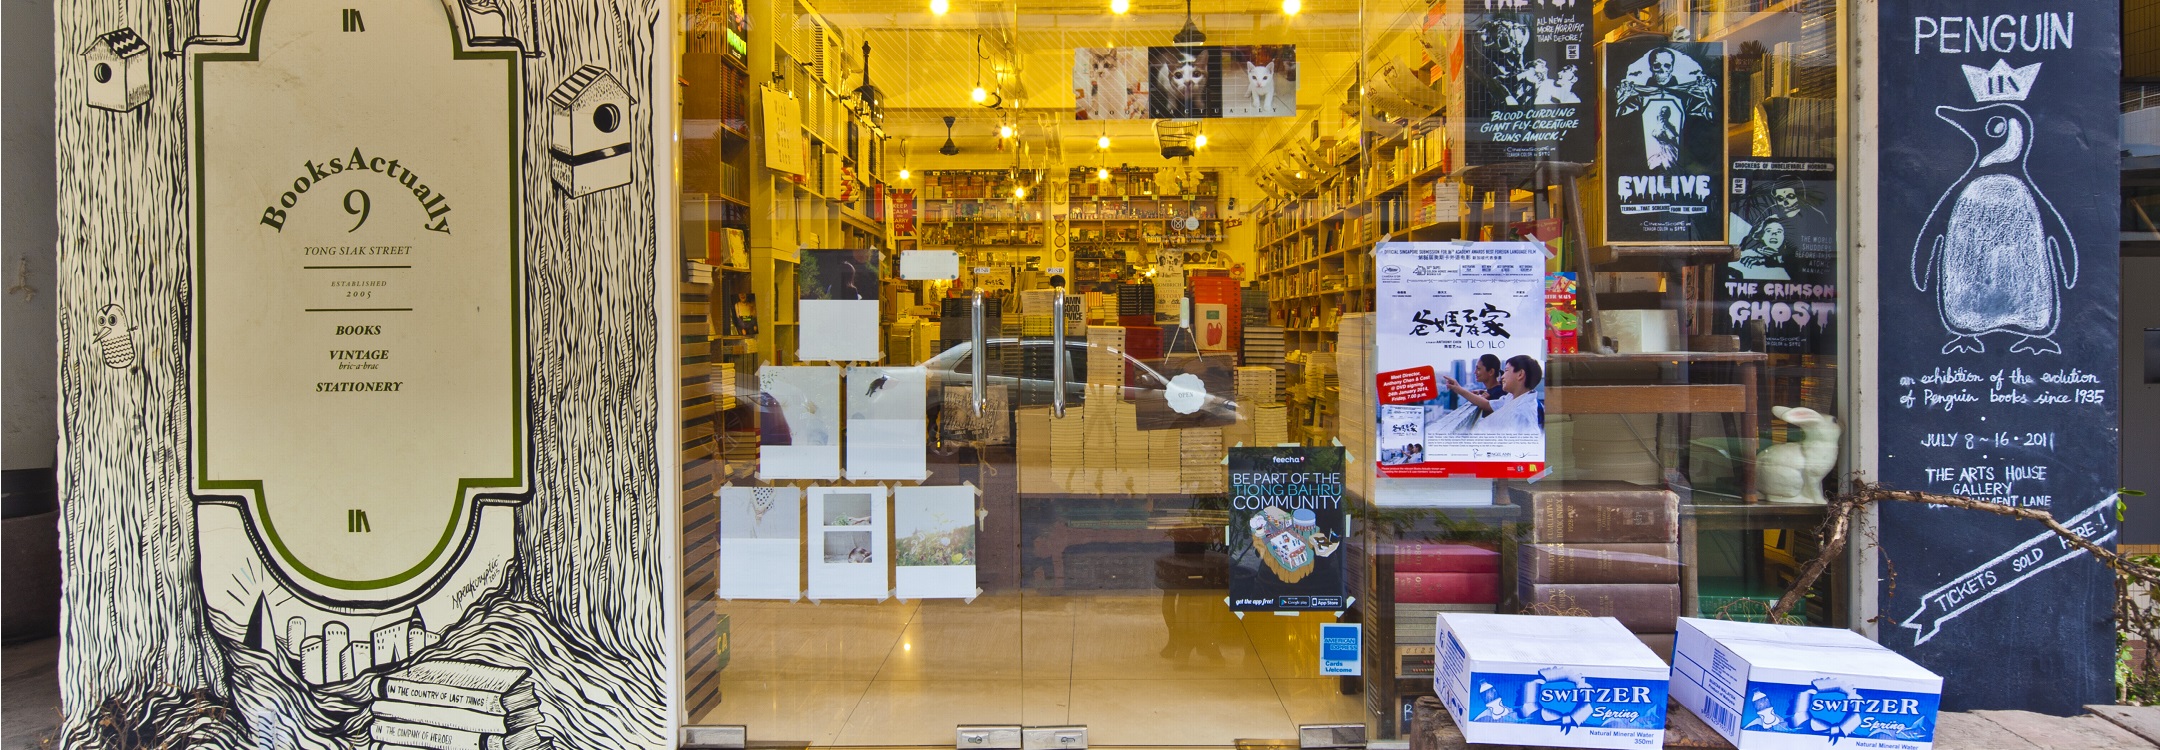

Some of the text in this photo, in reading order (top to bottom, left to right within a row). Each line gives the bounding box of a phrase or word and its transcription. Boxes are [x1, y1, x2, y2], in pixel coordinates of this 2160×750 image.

[1537, 18, 1547, 26] ALL
[1548, 14, 1564, 24] NEW
[1537, 22, 1584, 34] MORE HORRIFIC
[1914, 11, 2074, 54] PENGUIN
[1536, 33, 1552, 42] THAN
[1491, 108, 1576, 122] BLOOD-CURDLING
[1480, 119, 1579, 133] GIANT FLY-CREATURE
[1492, 132, 1521, 142] RUNS
[260, 146, 451, 235] BooksActually
[1618, 175, 1711, 203] EVILIVE
[343, 189, 371, 233] 9
[1813, 236, 1833, 244] WORLD
[304, 246, 412, 255] YONG SIAK STREET
[346, 291, 372, 299] 2005
[1724, 281, 1835, 300] THE CRIMSON
[1064, 296, 1081, 304] AMN
[1728, 300, 1836, 334] GHOST
[335, 325, 382, 336] BOOKS
[1467, 340, 1484, 349] ILO
[1488, 340, 1505, 349] ILO
[329, 350, 389, 360] VINTAGE
[338, 361, 379, 370] bric-a-brac
[1900, 376, 1916, 385] an
[1920, 367, 1983, 384] exhibition
[1990, 368, 2004, 390] of
[2009, 368, 2034, 384] the
[315, 381, 403, 392] STATIONERY
[1900, 389, 2105, 411] of Penguin books since 1935
[1920, 432, 1958, 447] JULY
[1964, 433, 1974, 449] 8
[1994, 431, 2010, 448] 16
[2023, 432, 2055, 450] 2011
[1233, 473, 1340, 484] BE PART OF THE
[1925, 465, 2047, 484] THE ARTS HOUSE
[1233, 484, 1342, 496] TIONG BAHRU
[1952, 481, 2012, 496] GALLERY
[1233, 496, 1342, 510] COMMUNITY
[2023, 495, 2051, 507] LANE
[1934, 547, 2044, 611] TICKETS SOLD
[387, 684, 485, 707] IN THE COUNTRY OF LAST THINGS
[1541, 686, 1652, 704] SWITZER
[1811, 698, 1919, 715] SWITZER
[1592, 706, 1640, 722] Spring
[386, 726, 395, 736] THE
[1860, 717, 1906, 733] Spring
[1855, 740, 1877, 748] Natural
